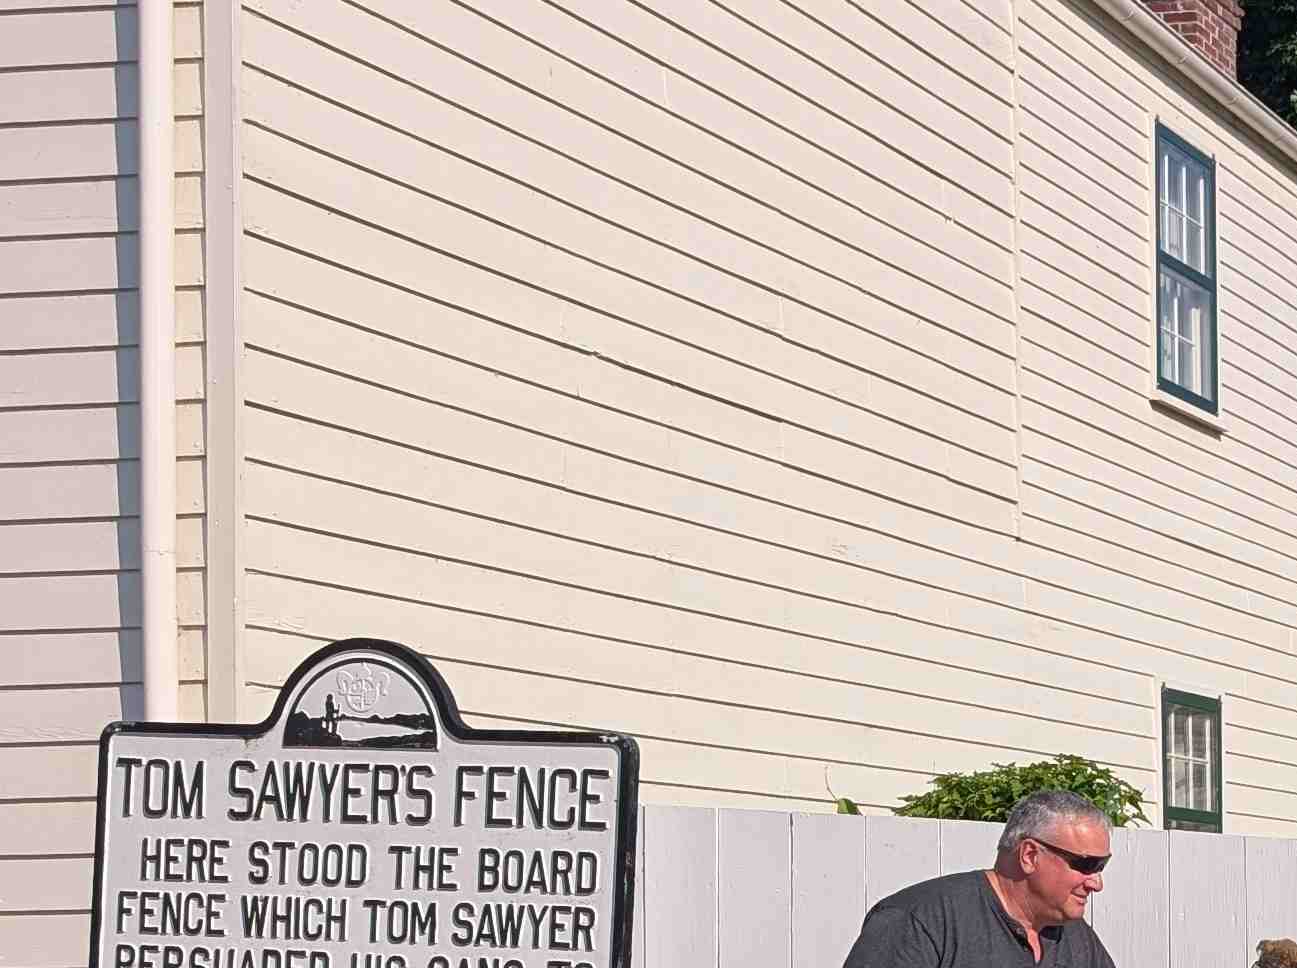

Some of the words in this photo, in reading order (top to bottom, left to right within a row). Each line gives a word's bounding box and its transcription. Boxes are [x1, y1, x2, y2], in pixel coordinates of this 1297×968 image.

[114, 757, 205, 821] TOM
[226, 760, 436, 828] SAWYER'S
[452, 765, 611, 833] FENCE
[139, 837, 231, 885] HERE
[247, 840, 369, 890] STOOD
[387, 845, 460, 893] THE
[476, 847, 599, 898] BOARD
[115, 890, 227, 939] FENCE
[240, 895, 348, 943] WHICH
[361, 899, 438, 947] TOM
[450, 902, 597, 954] SAWYER
